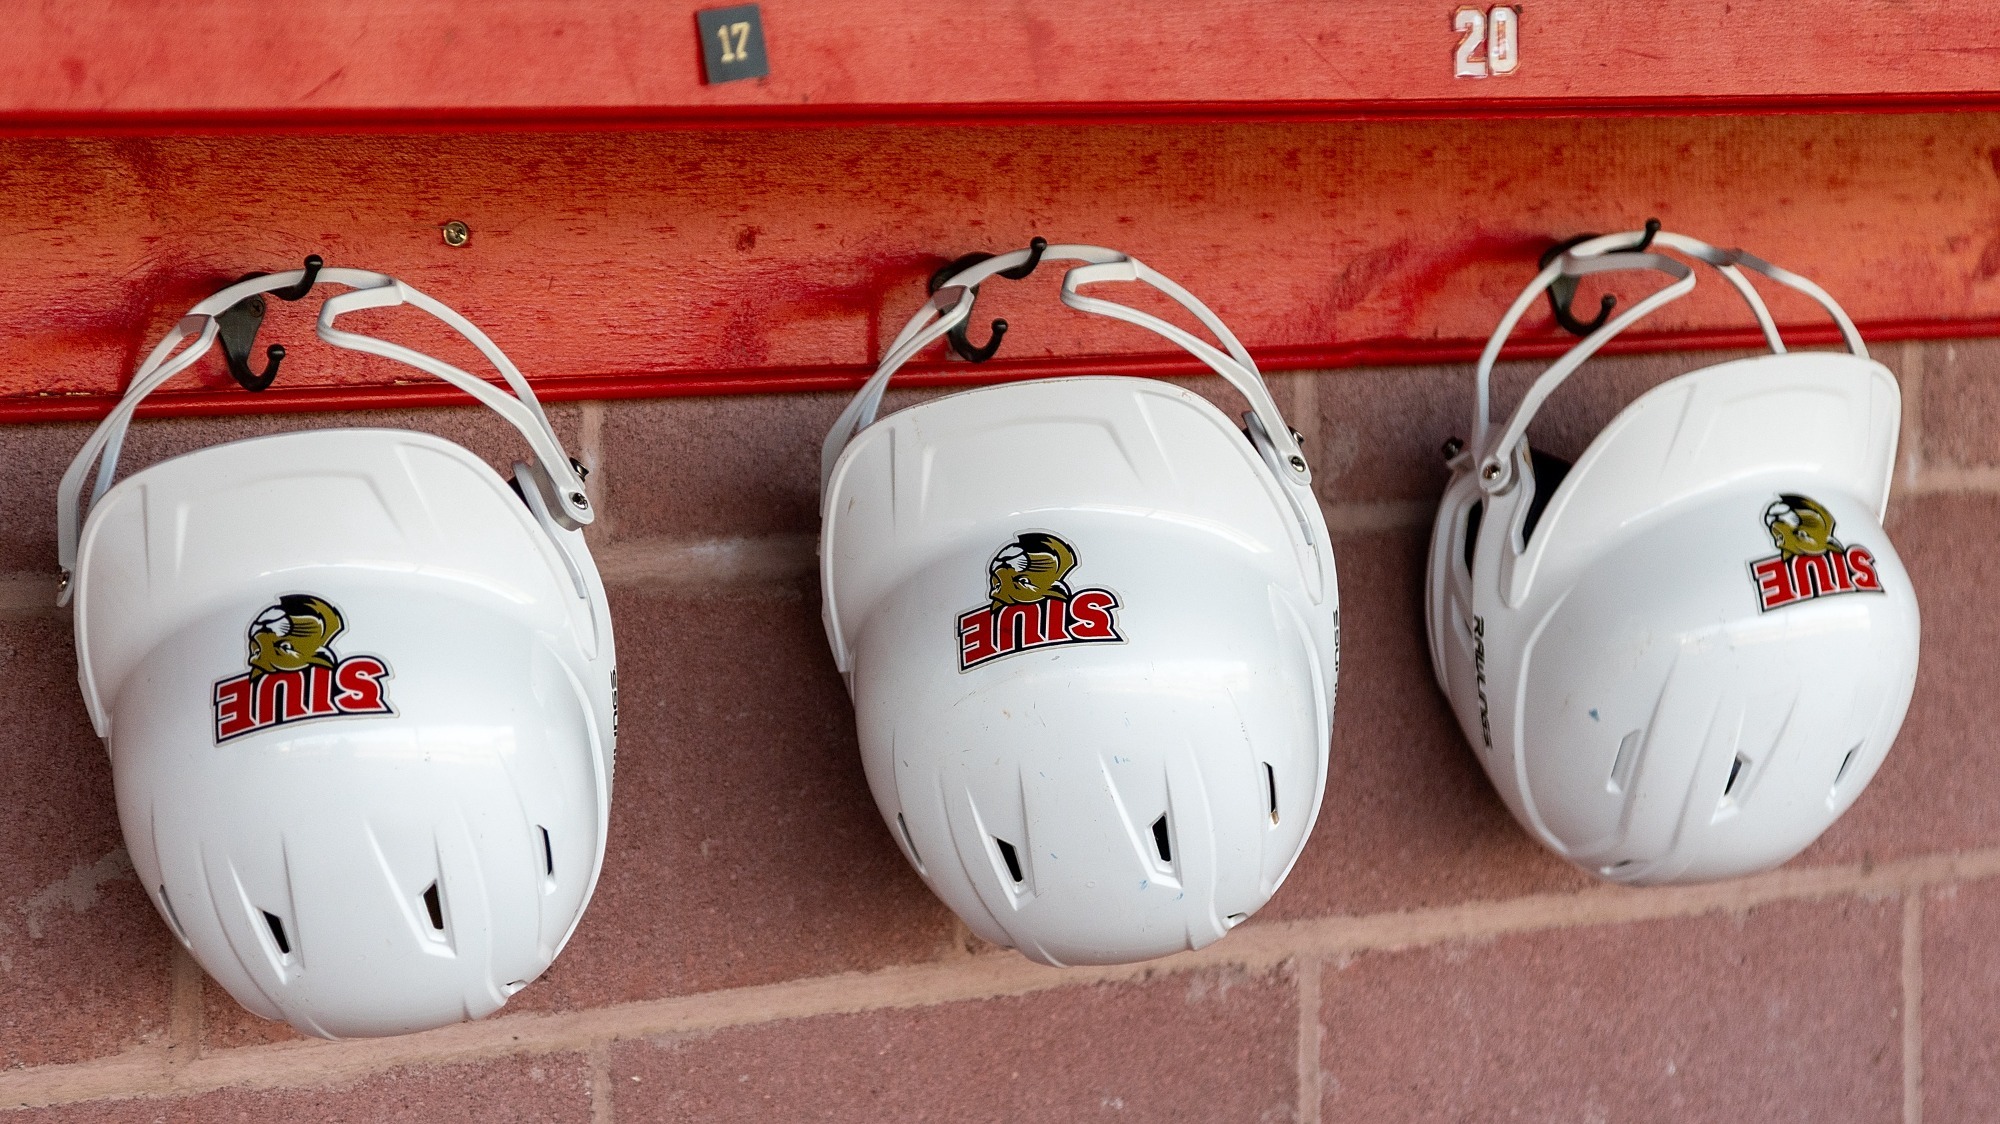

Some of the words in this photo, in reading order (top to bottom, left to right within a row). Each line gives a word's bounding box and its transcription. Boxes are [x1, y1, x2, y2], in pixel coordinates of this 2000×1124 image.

[717, 21, 750, 64] 17
[1454, 5, 1520, 78] 20
[1750, 545, 1884, 612] SIUE
[957, 589, 1123, 671] SIUE
[214, 656, 393, 744] SIUE
